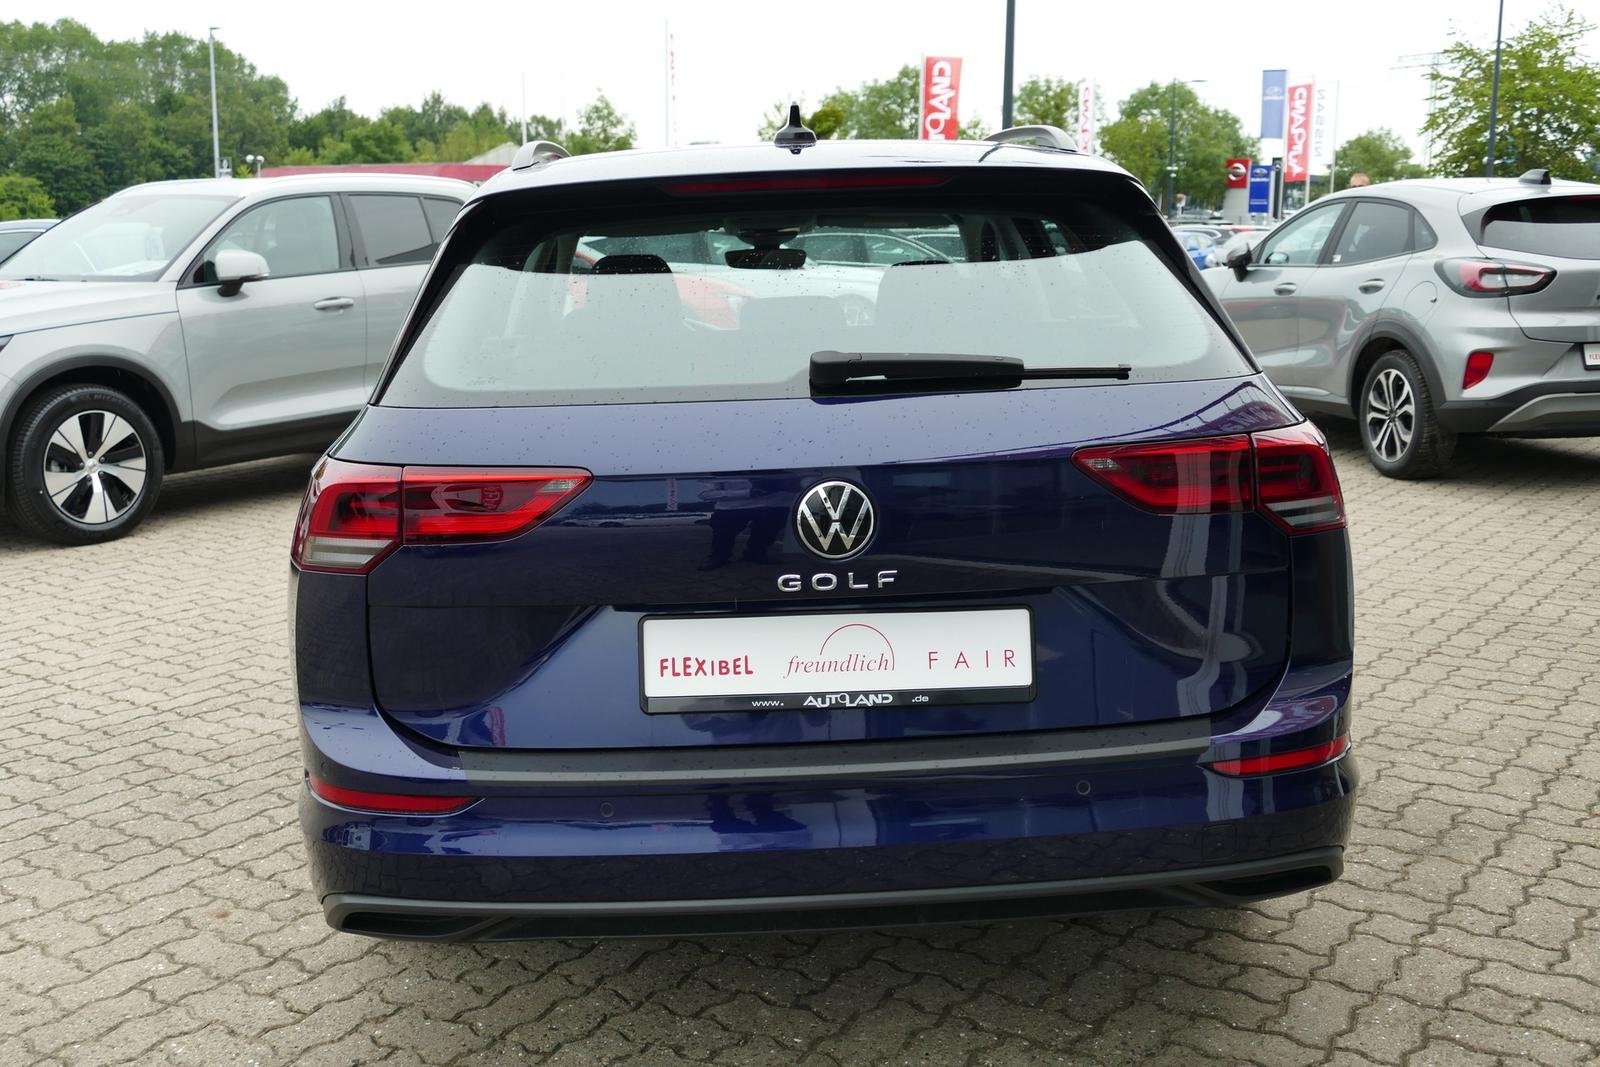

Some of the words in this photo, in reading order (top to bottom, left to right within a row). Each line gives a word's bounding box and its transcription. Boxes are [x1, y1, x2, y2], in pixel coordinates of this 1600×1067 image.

[777, 570, 898, 592] GOLF
[659, 655, 753, 677] FLEXIBEL
[782, 653, 889, 679] freundlich
[928, 649, 1016, 669] FAIR
[803, 693, 893, 708] AUTOLAND
[911, 694, 929, 703] .de
